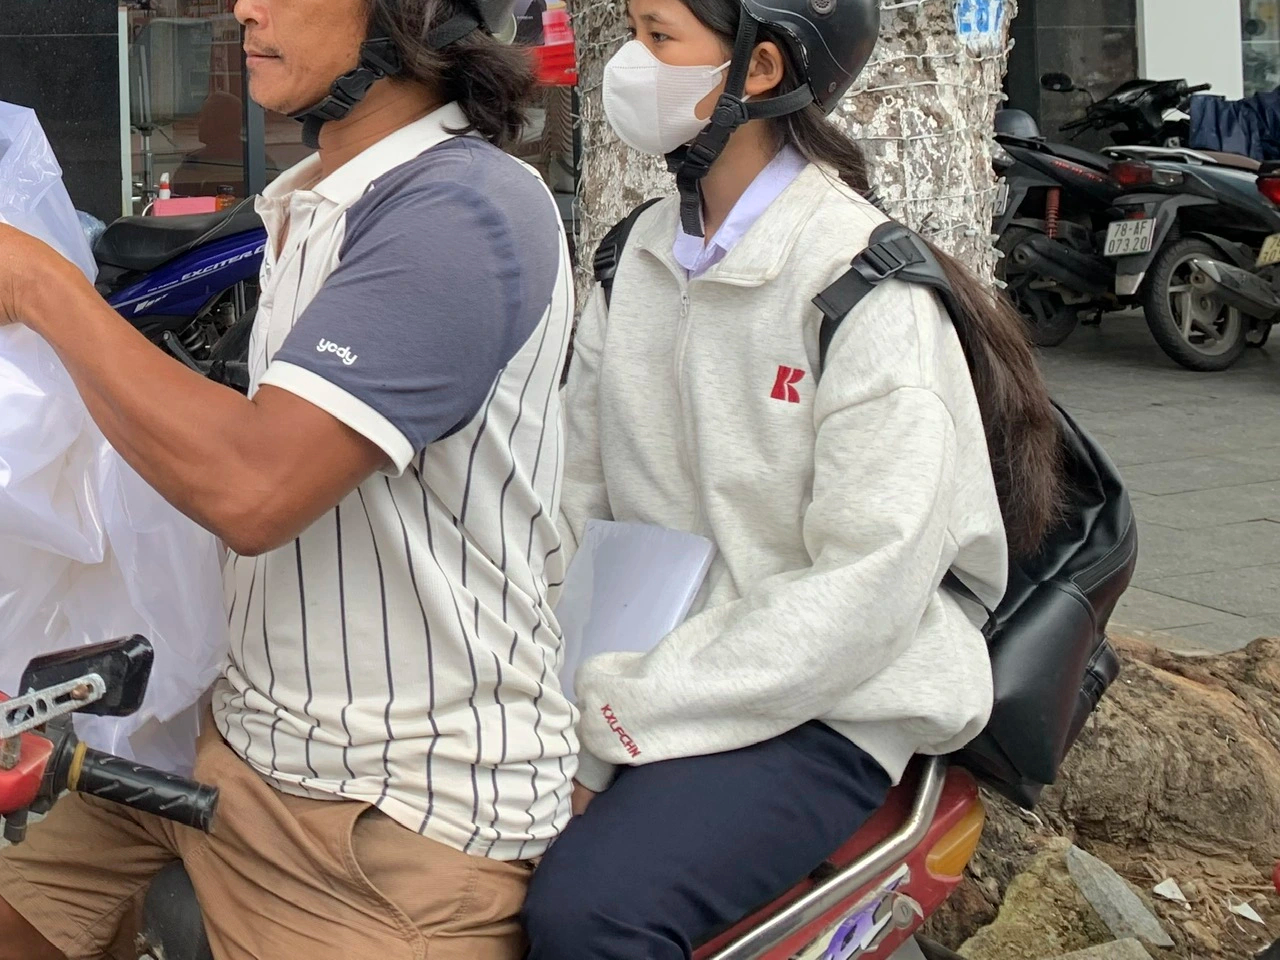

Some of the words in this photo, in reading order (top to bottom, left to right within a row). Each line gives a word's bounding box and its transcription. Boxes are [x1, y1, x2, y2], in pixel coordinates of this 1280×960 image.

[1113, 220, 1148, 238] 78-AF
[181, 249, 254, 281] EXCITER
[316, 337, 358, 365] yody
[770, 364, 806, 404] K
